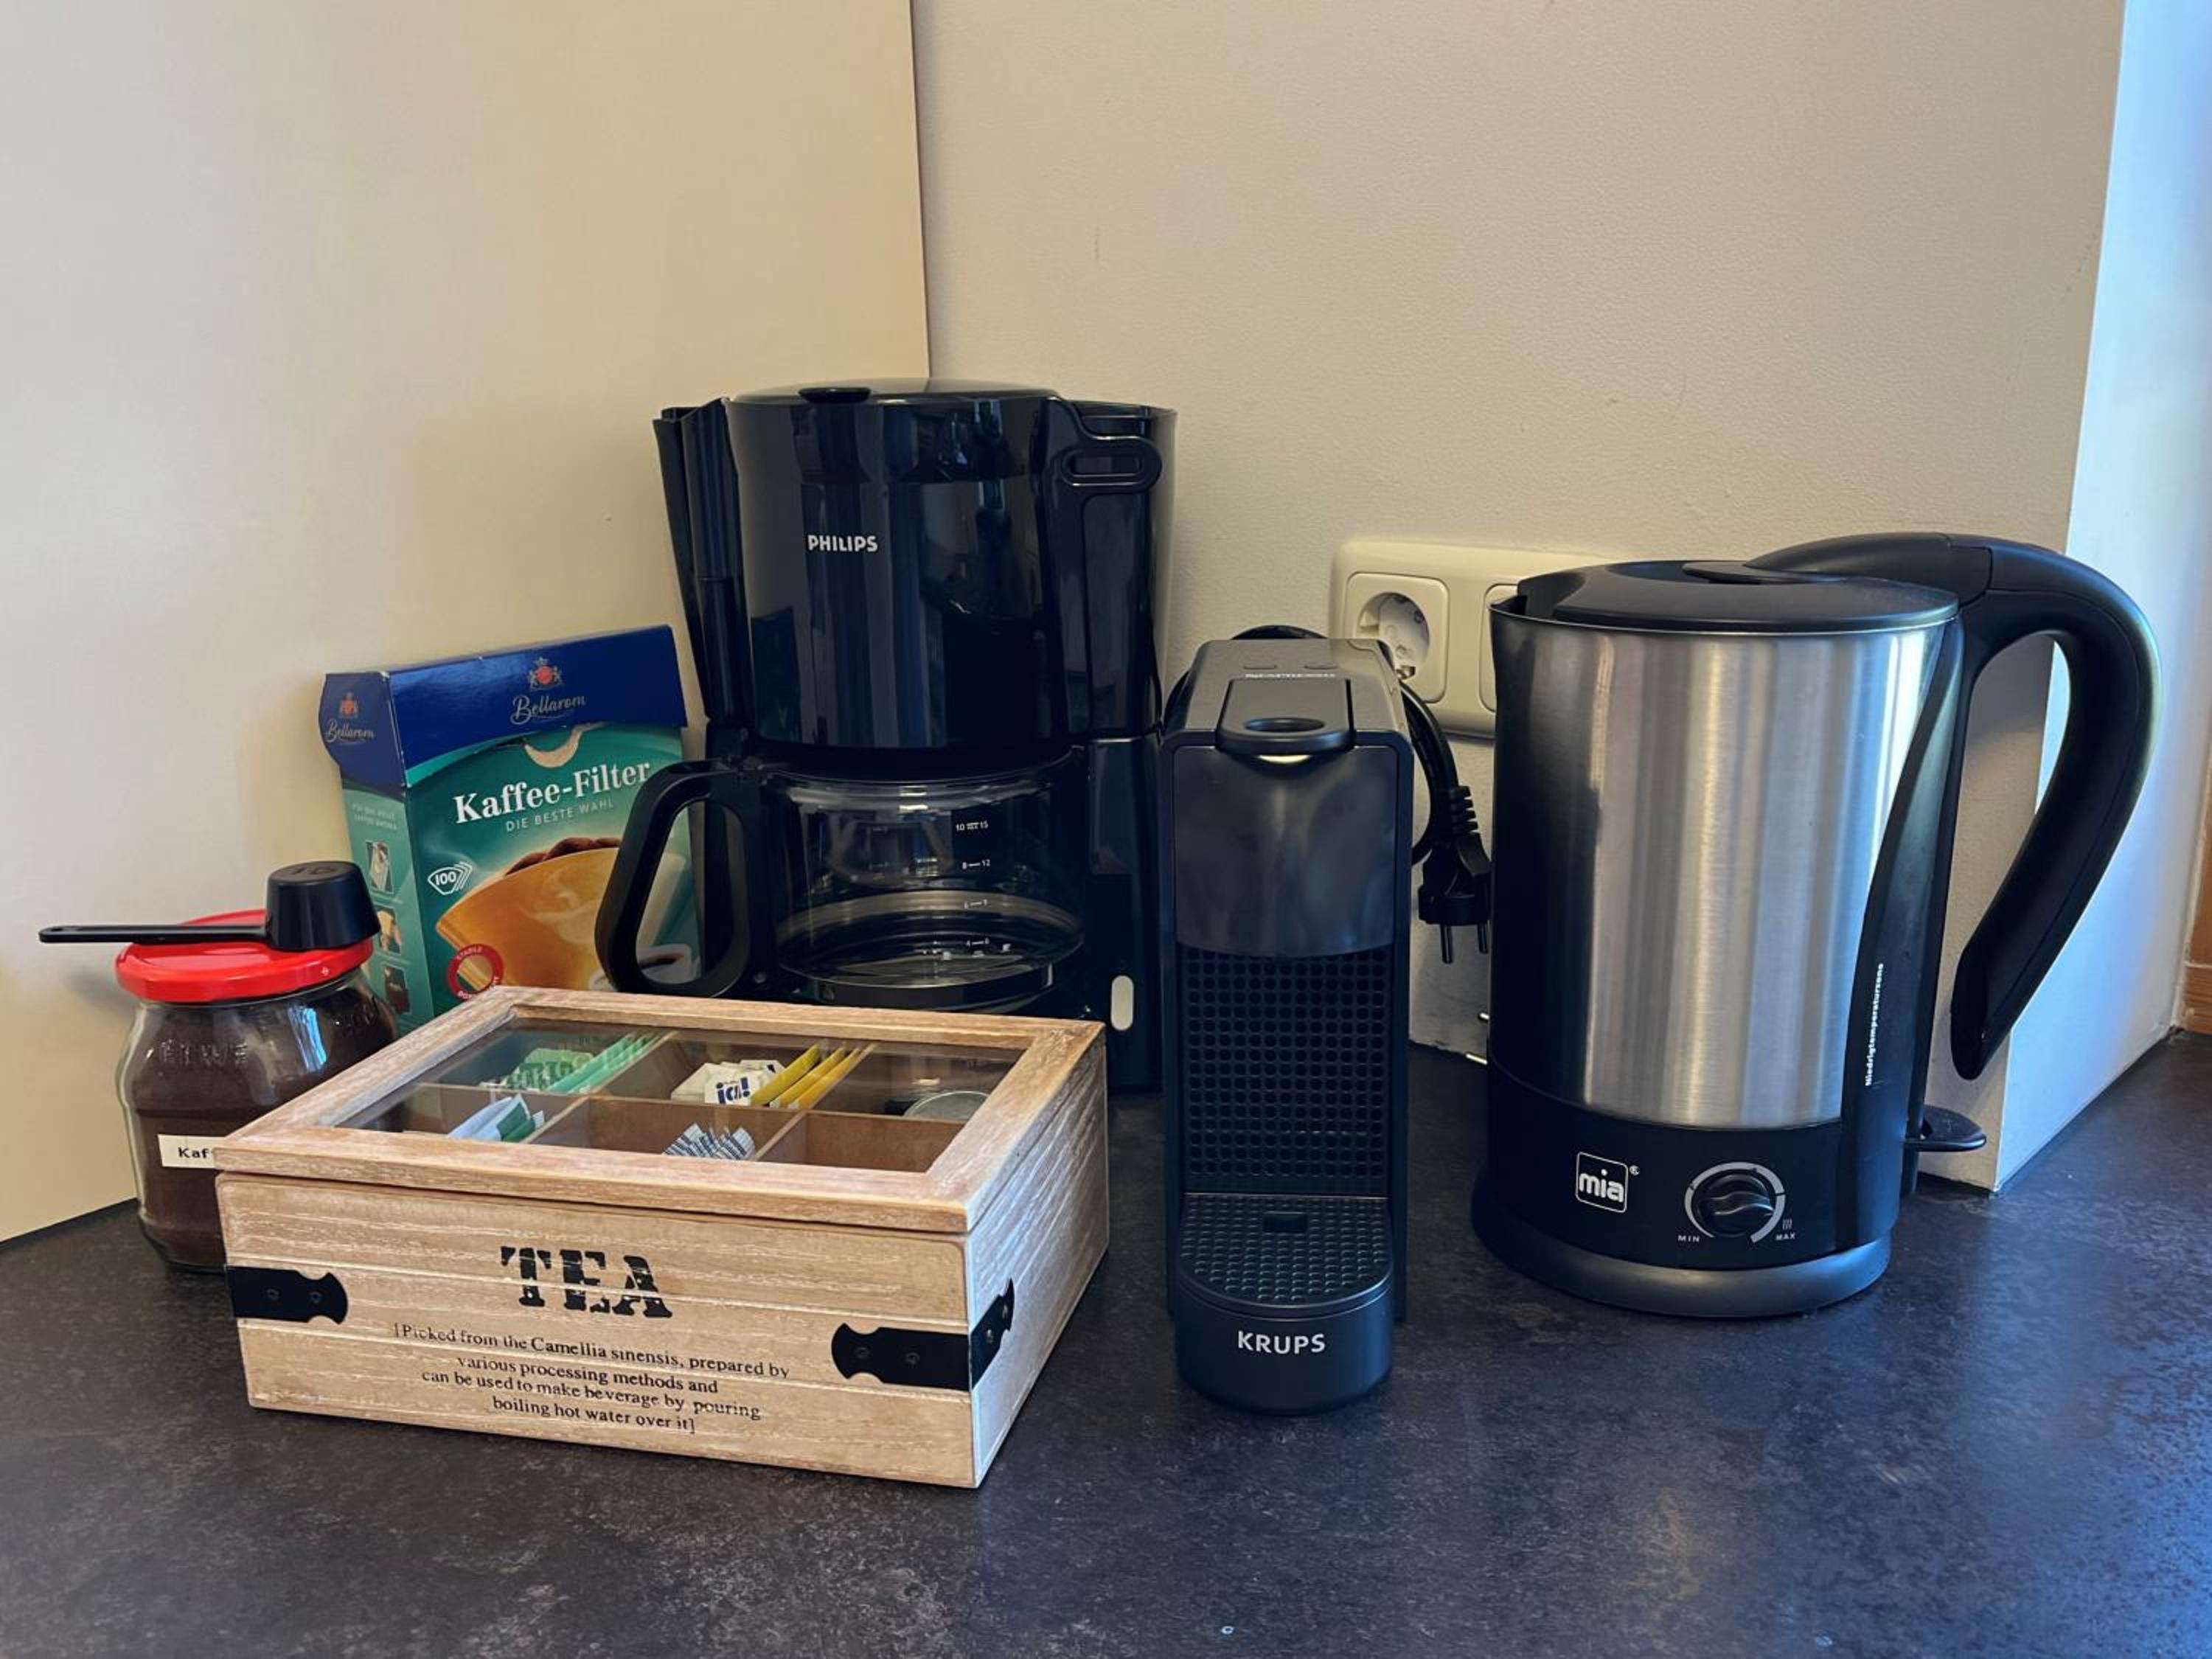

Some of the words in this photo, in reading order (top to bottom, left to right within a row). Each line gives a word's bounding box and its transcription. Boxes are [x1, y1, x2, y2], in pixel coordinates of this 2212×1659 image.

[807, 534, 879, 552] PHILIPS
[510, 695, 588, 725] Bellarom
[325, 718, 374, 743] Bellarom
[452, 762, 650, 824] Kaffee-Filter
[506, 818, 529, 832] DIE
[535, 808, 574, 826] BESTE
[579, 797, 615, 814] WAHL
[435, 871, 456, 886] 100
[178, 1147, 213, 1159] Kaf
[1579, 1169, 1624, 1203] mia
[1677, 1234, 1700, 1242] MIN
[499, 1245, 673, 1318] TEA
[460, 1327, 498, 1347] from
[503, 1335, 528, 1349] the
[530, 1337, 608, 1358] Camellia
[611, 1349, 684, 1368] sinensis,
[688, 1357, 765, 1376] prepared
[769, 1362, 790, 1379] by
[1237, 1330, 1326, 1354] KRUPS
[457, 1356, 518, 1373] various
[520, 1363, 609, 1385] processing
[613, 1373, 684, 1391] methods
[688, 1380, 719, 1394] and
[421, 1371, 449, 1384] can
[453, 1371, 472, 1386] be
[476, 1376, 514, 1391] used
[516, 1380, 533, 1393] to
[536, 1382, 581, 1398] make
[584, 1385, 661, 1408] beverage
[664, 1393, 685, 1412] by
[692, 1400, 761, 1421] pouring
[493, 1396, 552, 1418] boiling
[554, 1402, 580, 1419] hot
[585, 1408, 633, 1424] water
[635, 1414, 674, 1428] over
[676, 1416, 695, 1434] it]
